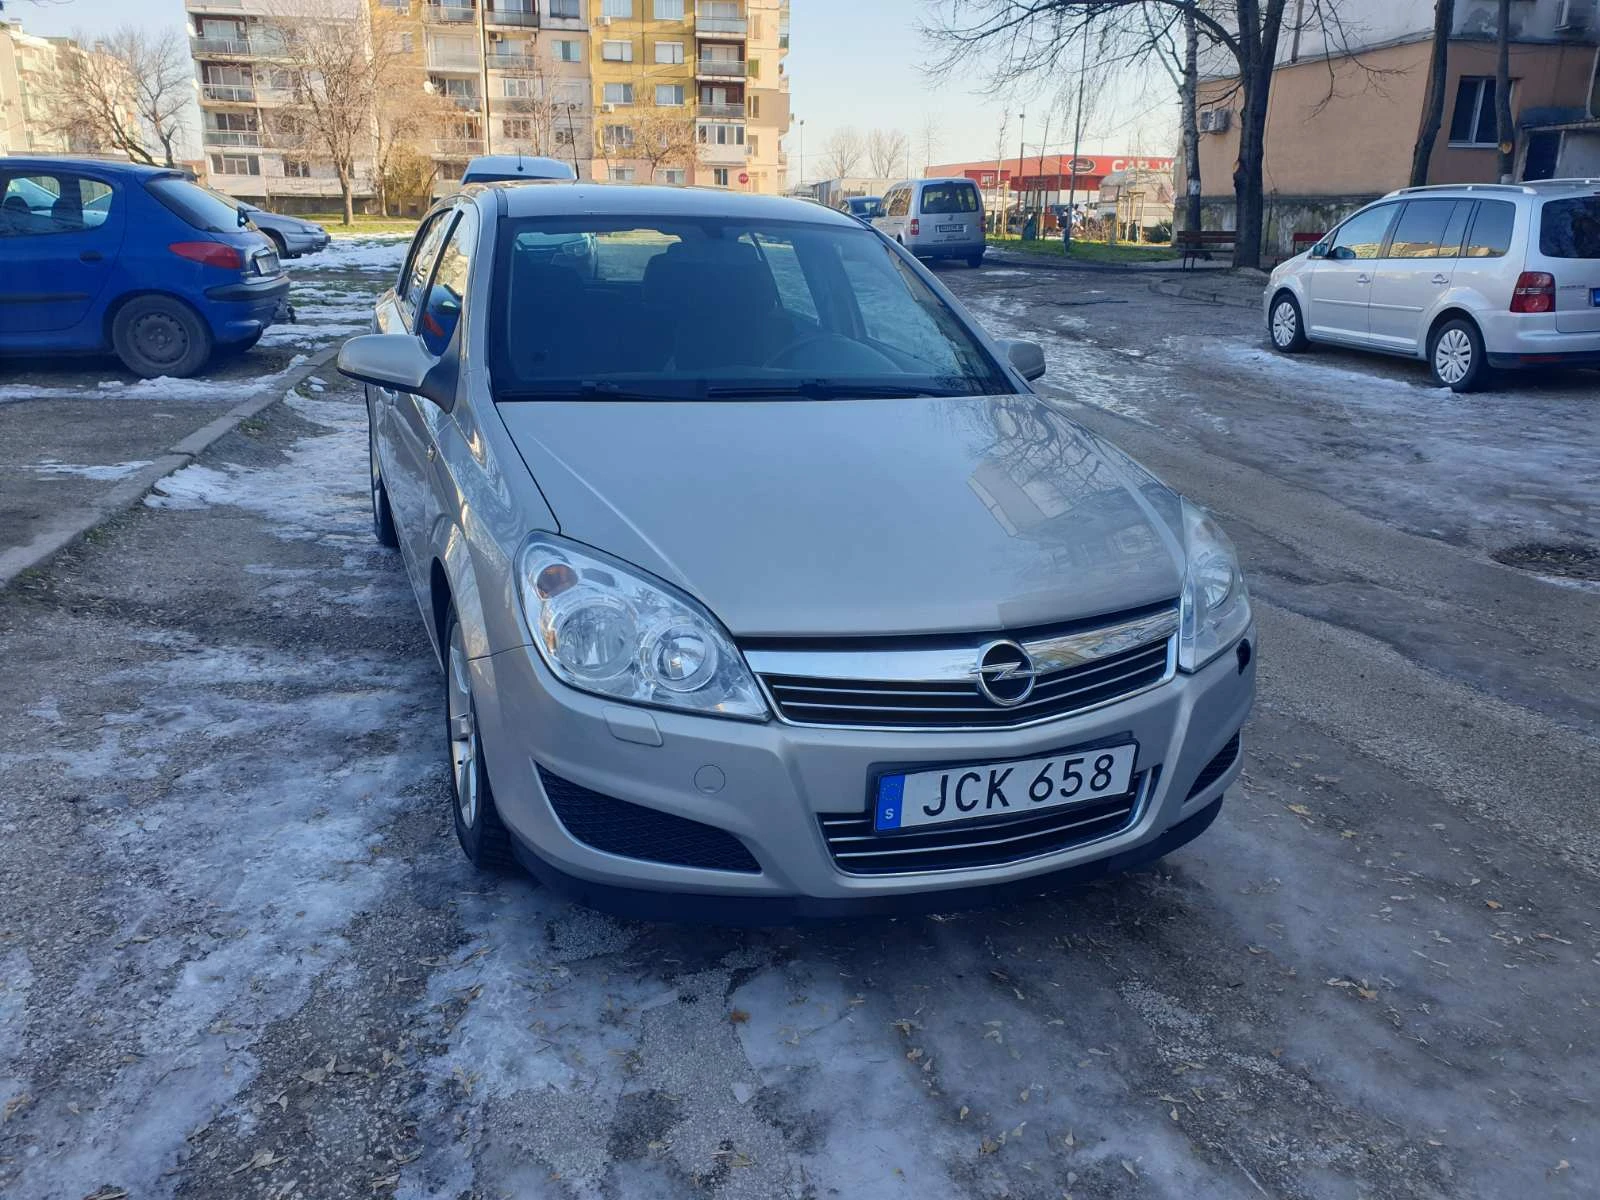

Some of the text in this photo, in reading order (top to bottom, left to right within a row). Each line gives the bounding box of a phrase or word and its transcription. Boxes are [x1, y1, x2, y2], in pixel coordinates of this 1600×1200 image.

[923, 754, 1114, 817] JCK 658
[885, 808, 894, 820] S
